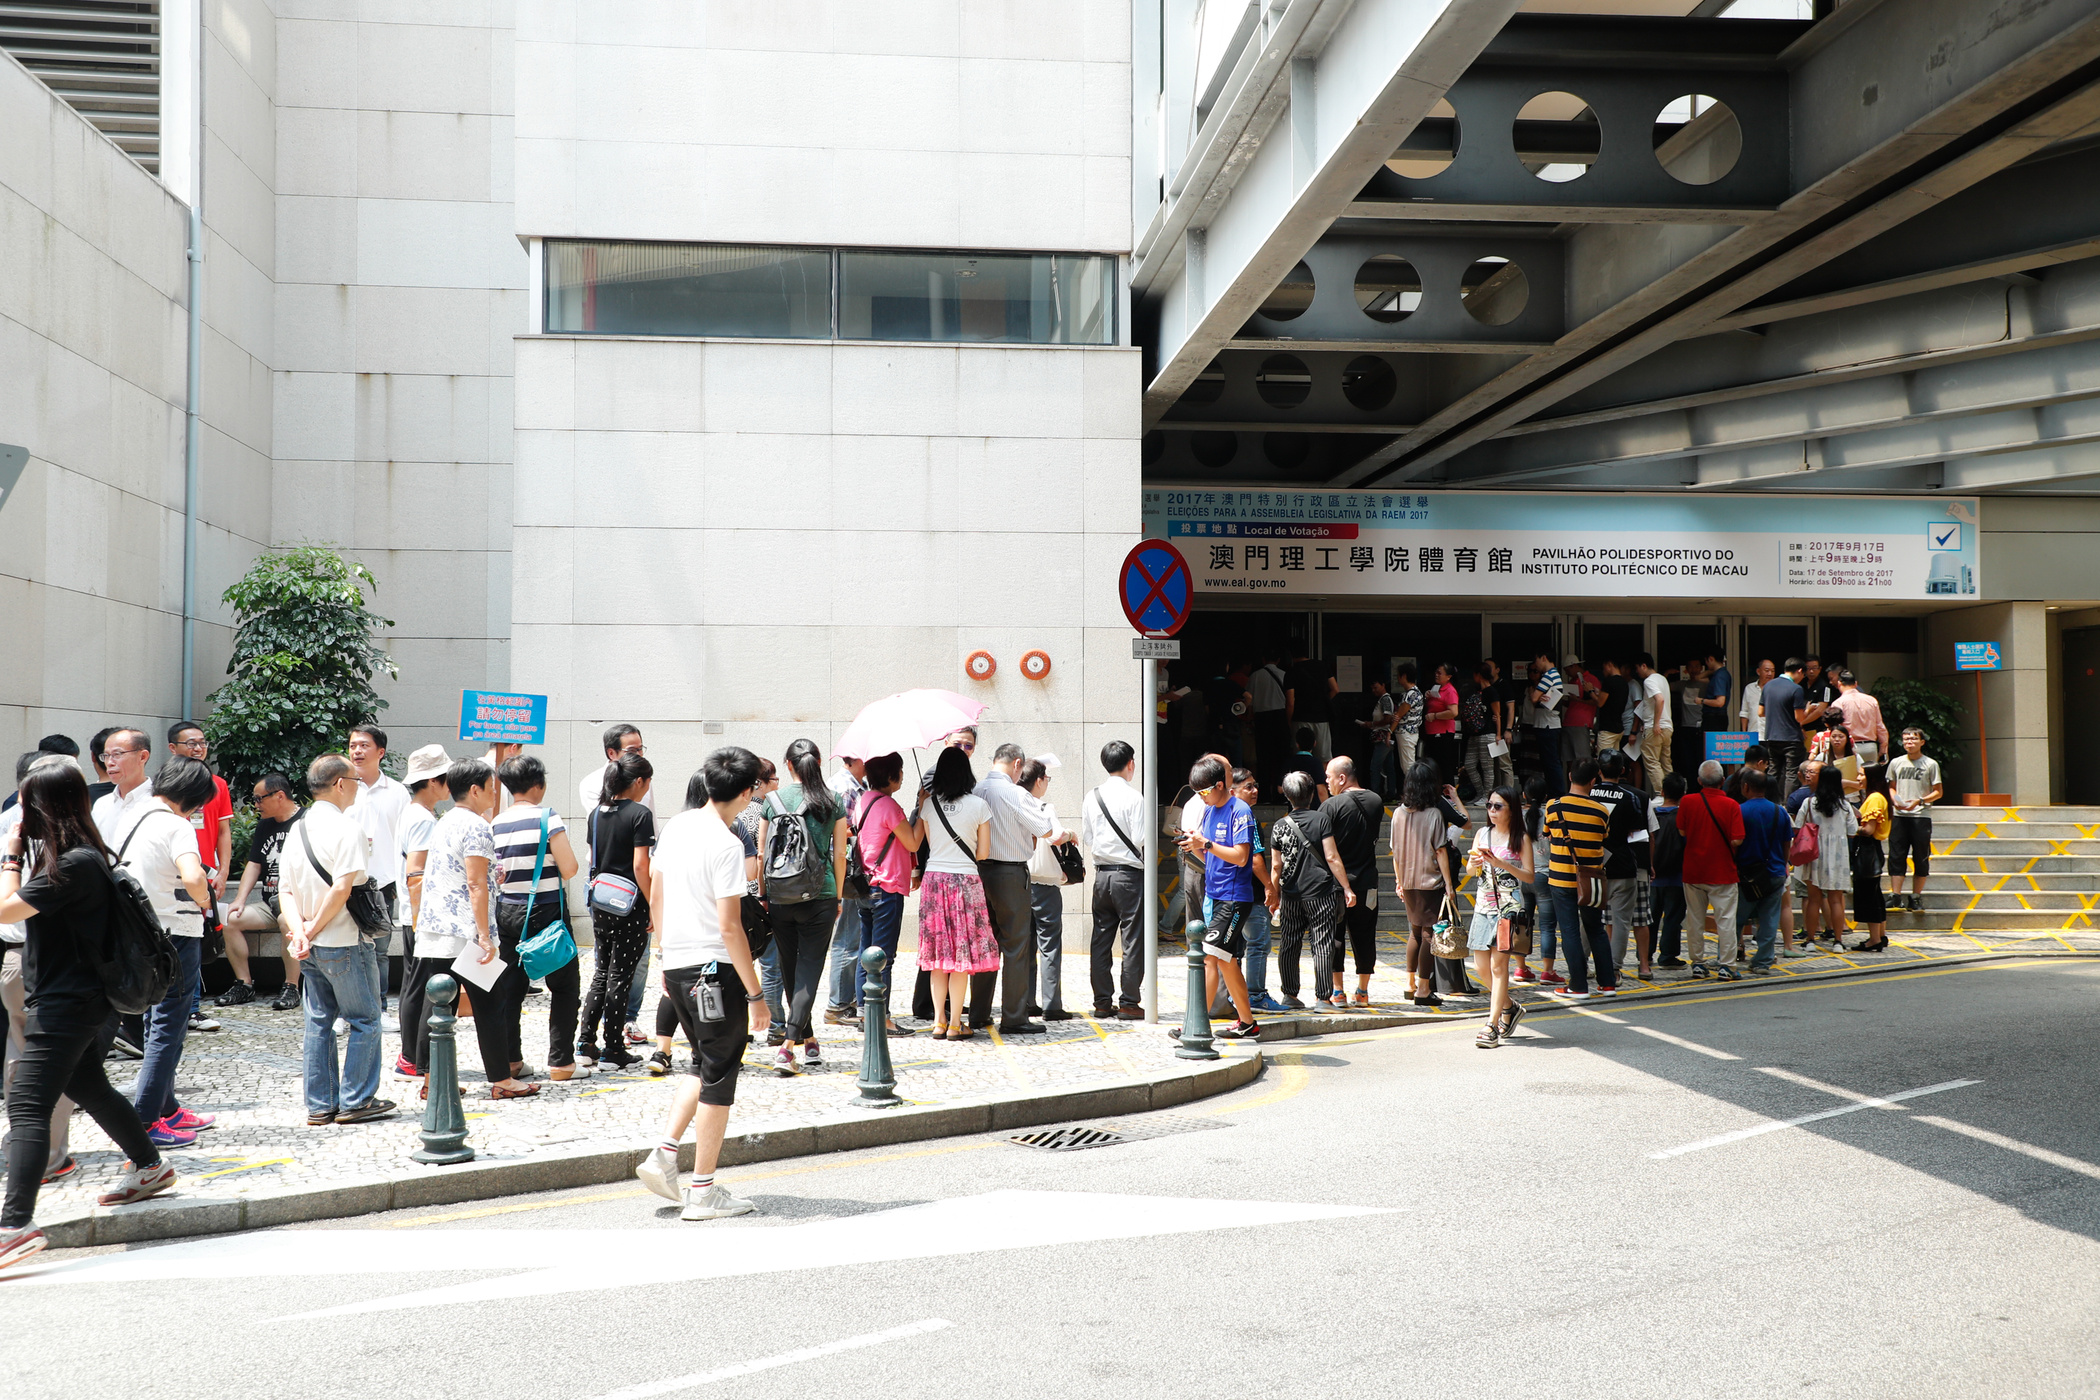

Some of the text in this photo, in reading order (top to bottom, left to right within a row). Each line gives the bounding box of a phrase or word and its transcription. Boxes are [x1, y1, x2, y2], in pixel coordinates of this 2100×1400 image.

[1167, 492, 1429, 508] 2017年澳門特別行政區立法會選舉
[1167, 505, 1210, 518] ELEIÇÕES
[1213, 508, 1237, 517] PARA
[1240, 508, 1247, 517] A
[1250, 508, 1304, 518] ASSEMBLEIA
[1308, 509, 1362, 519] LEGISLATIVA
[1365, 510, 1378, 519] DA
[1381, 510, 1406, 519] RAEM
[1410, 510, 1429, 520] 2017
[1181, 523, 1330, 537] 投票地點 Local de Votação
[1209, 544, 1512, 573] 澳門理工學院體育館
[1532, 546, 1734, 560] PAVILHÃO POLIDESPORTIVO DO
[1521, 562, 1749, 576] INSTITUTO POLITÉCNICO DE MACAU
[1828, 569, 1864, 577] Setembro
[1204, 578, 1286, 589] www.eal.gov.mo
[1831, 577, 1856, 586] 09h00
[1868, 577, 1892, 586] 21h00
[476, 706, 532, 723] 請勿停留
[468, 720, 538, 733] Por favor, não pare
[484, 731, 501, 739] área
[502, 732, 532, 741] amarela
[1898, 766, 1926, 780] NIKE
[1590, 789, 1624, 800] RONALDO
[261, 835, 275, 855] FEAR
